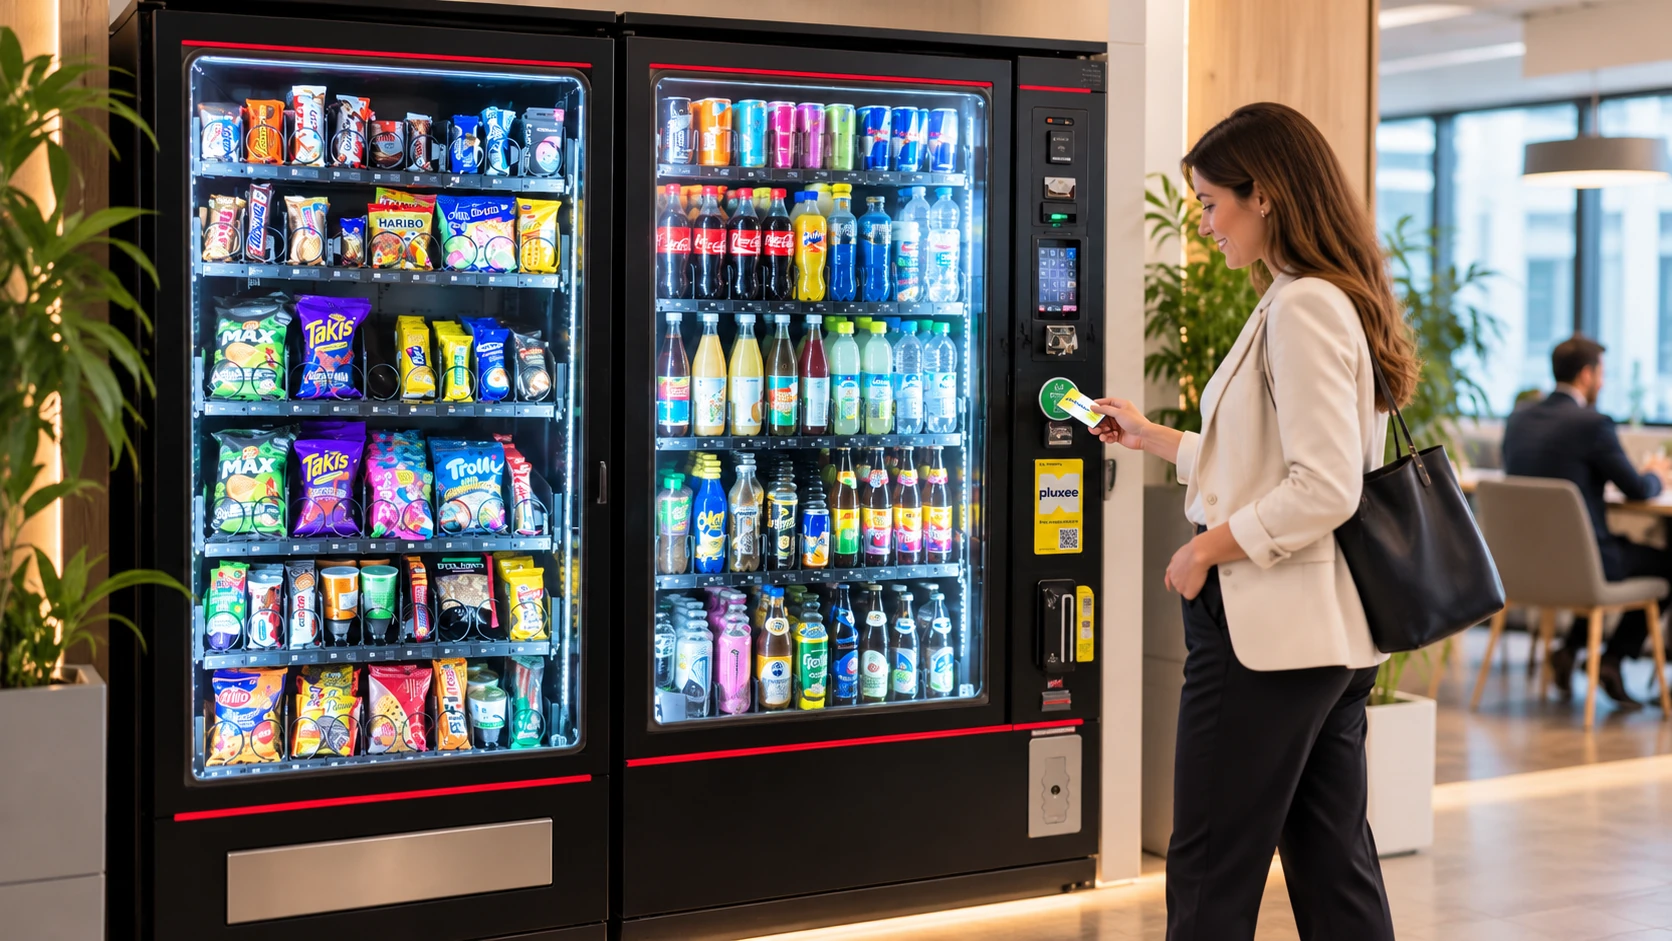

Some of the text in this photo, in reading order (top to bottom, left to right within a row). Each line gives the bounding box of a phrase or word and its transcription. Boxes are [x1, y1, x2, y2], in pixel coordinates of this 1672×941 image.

[379, 218, 424, 228] HARIBO
[222, 329, 276, 346] MAX
[222, 457, 276, 479] MAX
[446, 454, 505, 481] Trolli
[1039, 487, 1079, 501] pluxee
